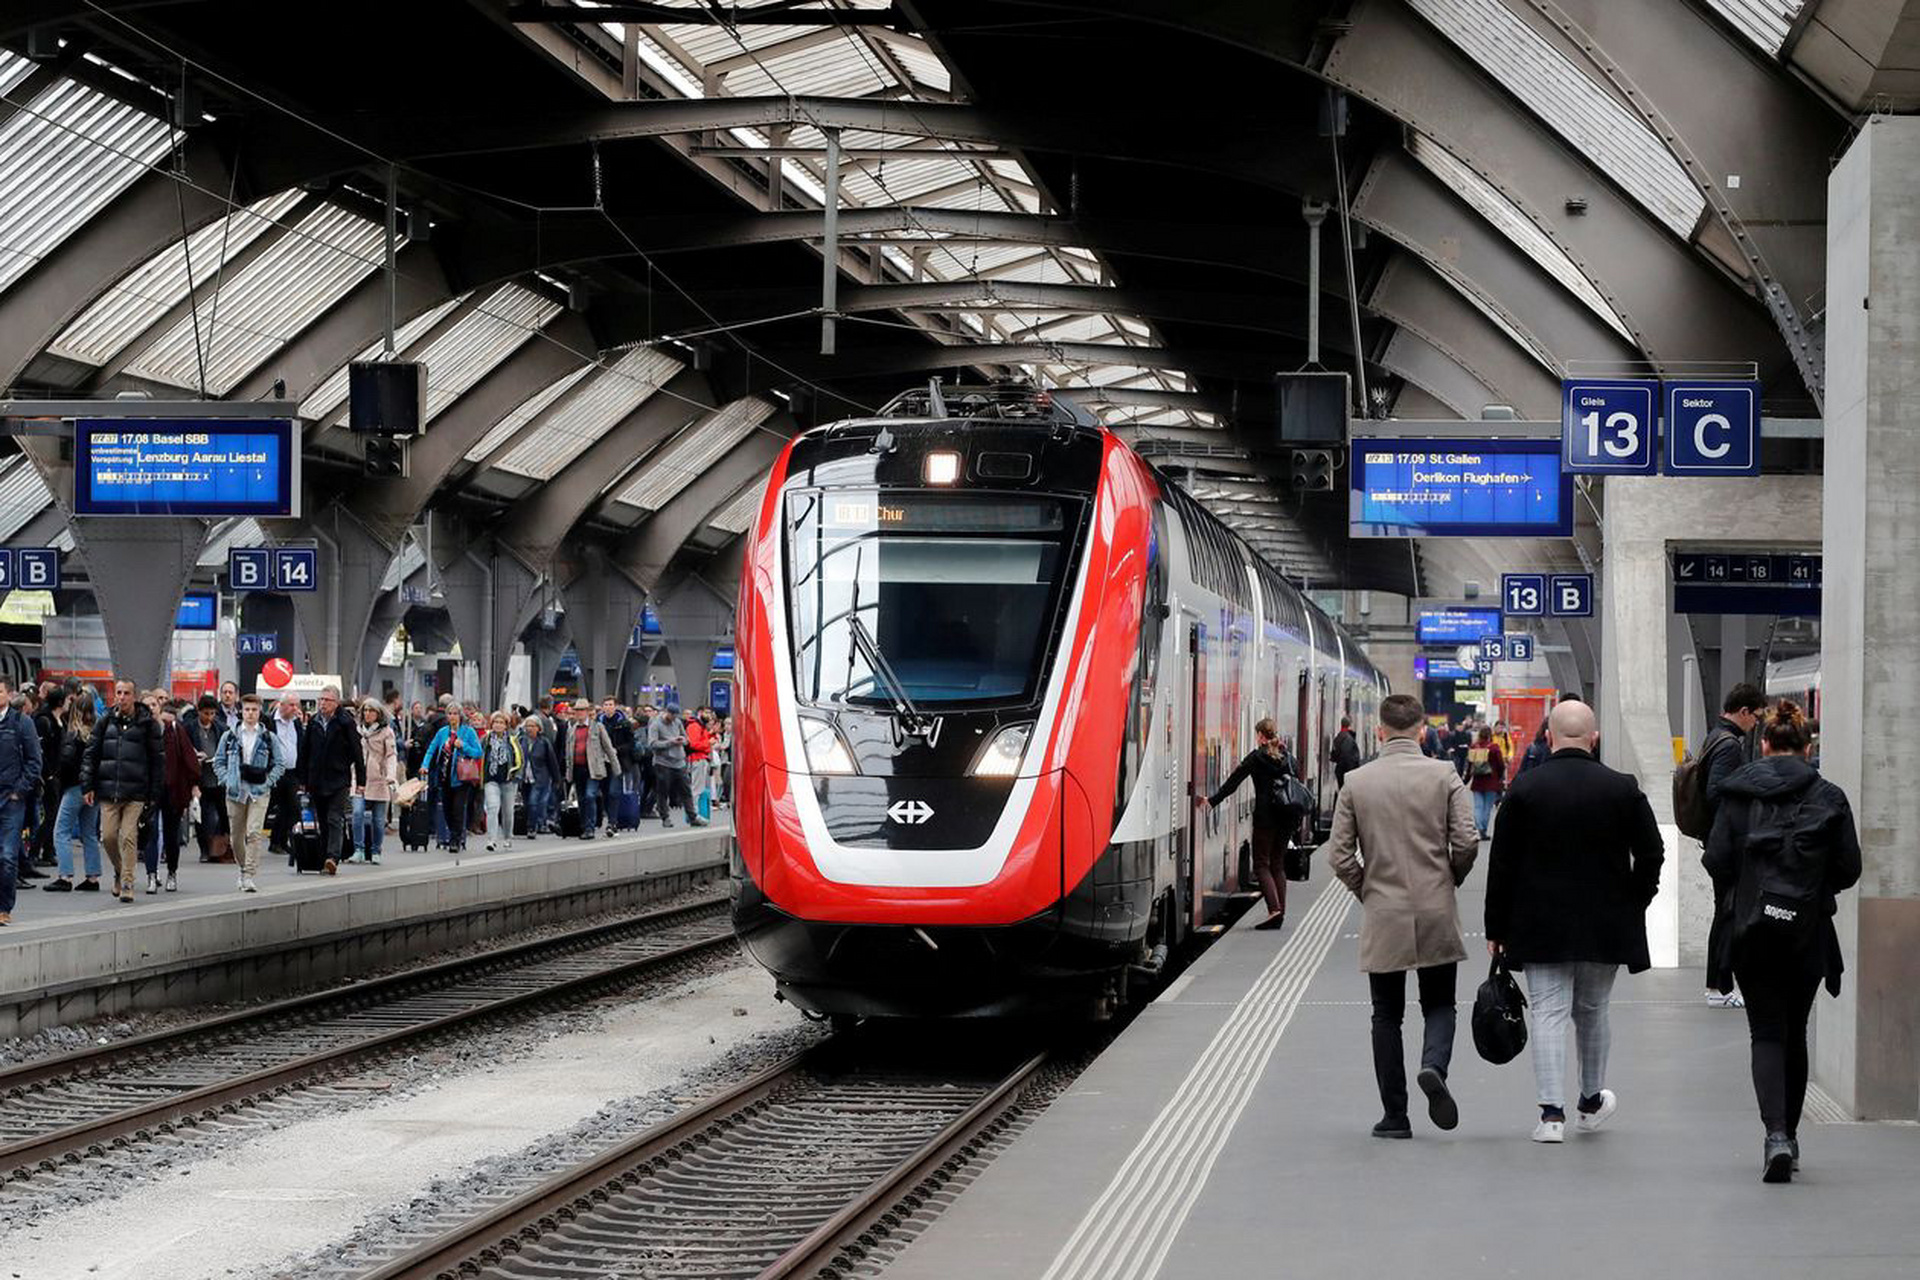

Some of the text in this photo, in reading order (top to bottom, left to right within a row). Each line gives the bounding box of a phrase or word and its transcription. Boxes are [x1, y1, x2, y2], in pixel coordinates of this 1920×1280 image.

[1580, 397, 1606, 407] Gleis
[1682, 398, 1714, 408] Sektor
[121, 433, 149, 444] 17.08
[152, 433, 184, 444] Basel
[185, 433, 209, 444] SBB
[1581, 411, 1639, 458] 13
[1693, 413, 1731, 459] C
[138, 452, 266, 465] Lenzburg Aarau Liestal
[1397, 454, 1425, 464] 17.09
[1429, 454, 1445, 464] St.
[1446, 454, 1482, 464] Gallen
[1414, 472, 1519, 485] Oerlikon Flughafen
[30, 562, 47, 583] B
[240, 562, 308, 584] B 14
[1708, 566, 1724, 577] 14
[1751, 566, 1767, 578] 18
[1793, 567, 1808, 578] 41
[1510, 587, 1580, 610] 13 B
[242, 641, 252, 651] A
[1485, 644, 1526, 657] 13 B
[1478, 662, 1490, 672] 13
